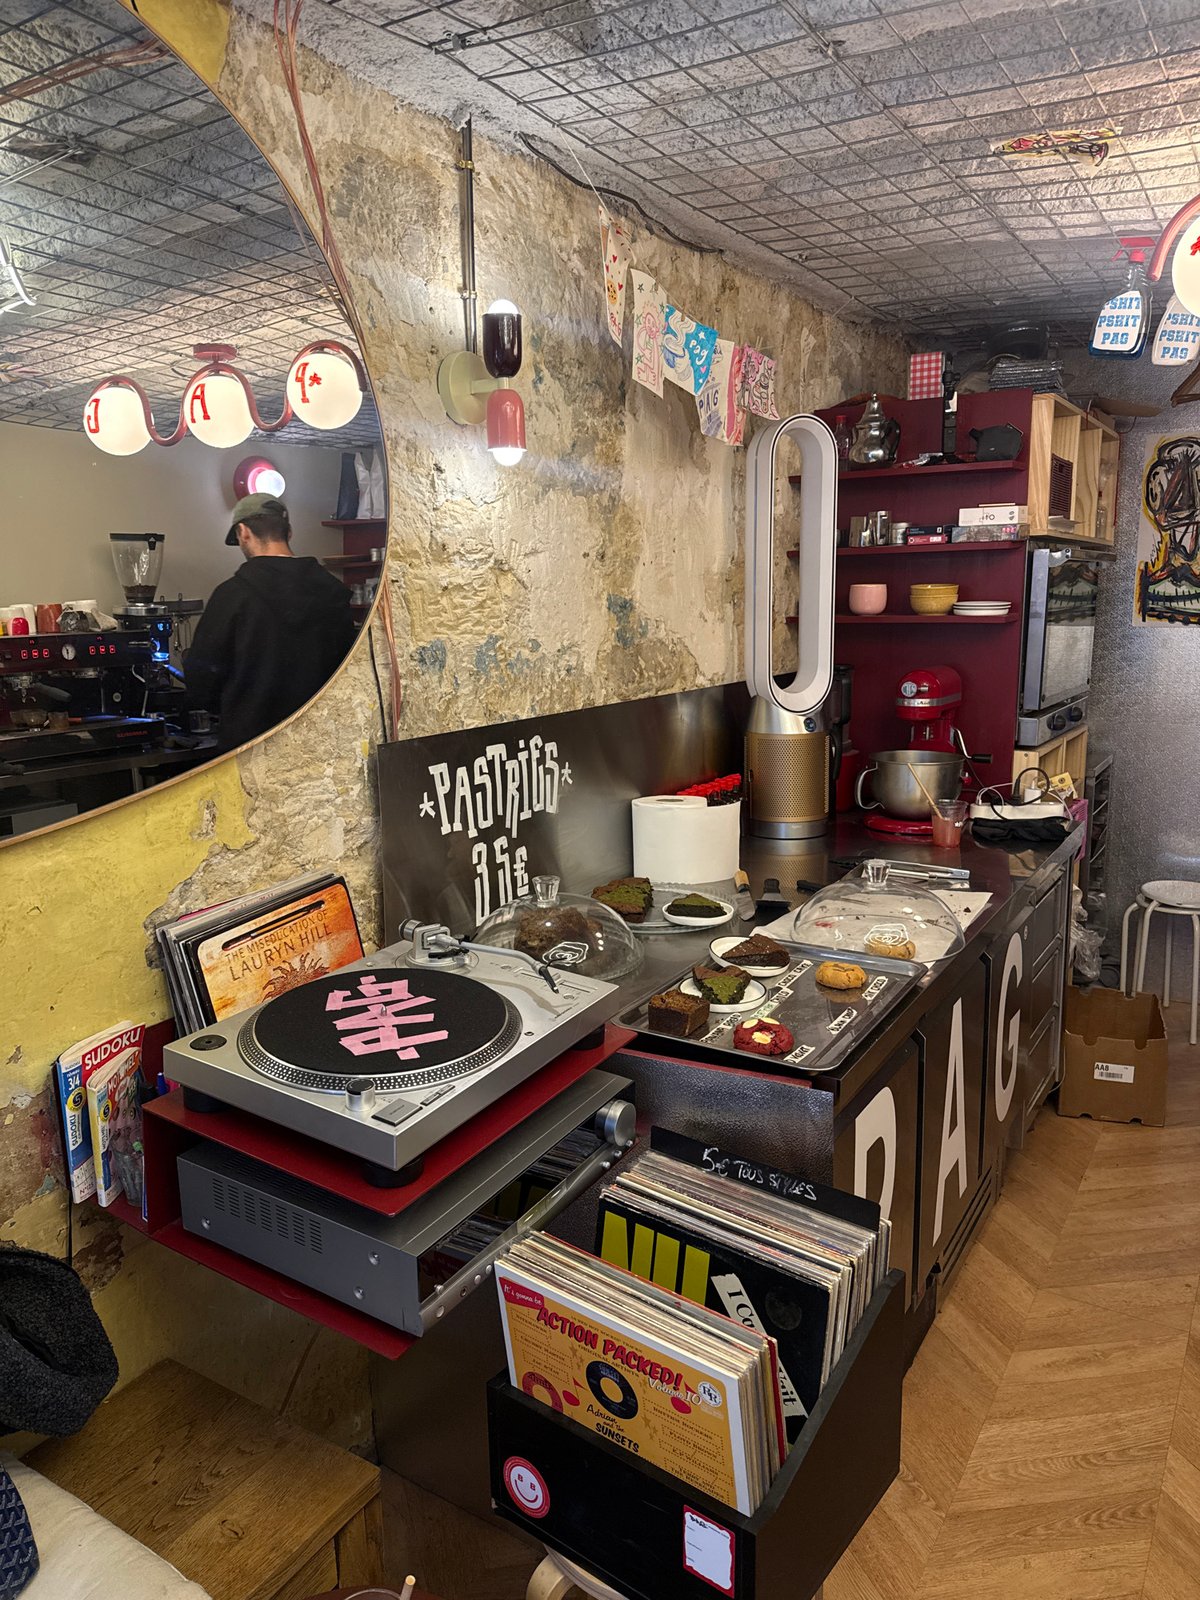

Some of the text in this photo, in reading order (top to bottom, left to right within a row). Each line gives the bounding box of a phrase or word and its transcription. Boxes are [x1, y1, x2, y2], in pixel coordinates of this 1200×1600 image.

[1098, 315, 1141, 327] PSHIT
[1101, 332, 1129, 344] PAG
[1159, 330, 1200, 343] PSHIT
[1160, 347, 1189, 359] PAG
[698, 389, 719, 410] PAG
[428, 734, 560, 839] PASTRIES
[225, 910, 329, 964] THE MISEDUCATION OF
[229, 922, 332, 982] LAURYN HILL
[84, 1027, 141, 1071] SUDOKU
[67, 1074, 80, 1091] 3/4
[69, 1114, 78, 1147] SUDOKU
[537, 1306, 598, 1350] ACTION
[602, 1339, 684, 1391] PACKED!
[586, 1404, 618, 1425] Adrian
[595, 1422, 640, 1453] SUNSETS
